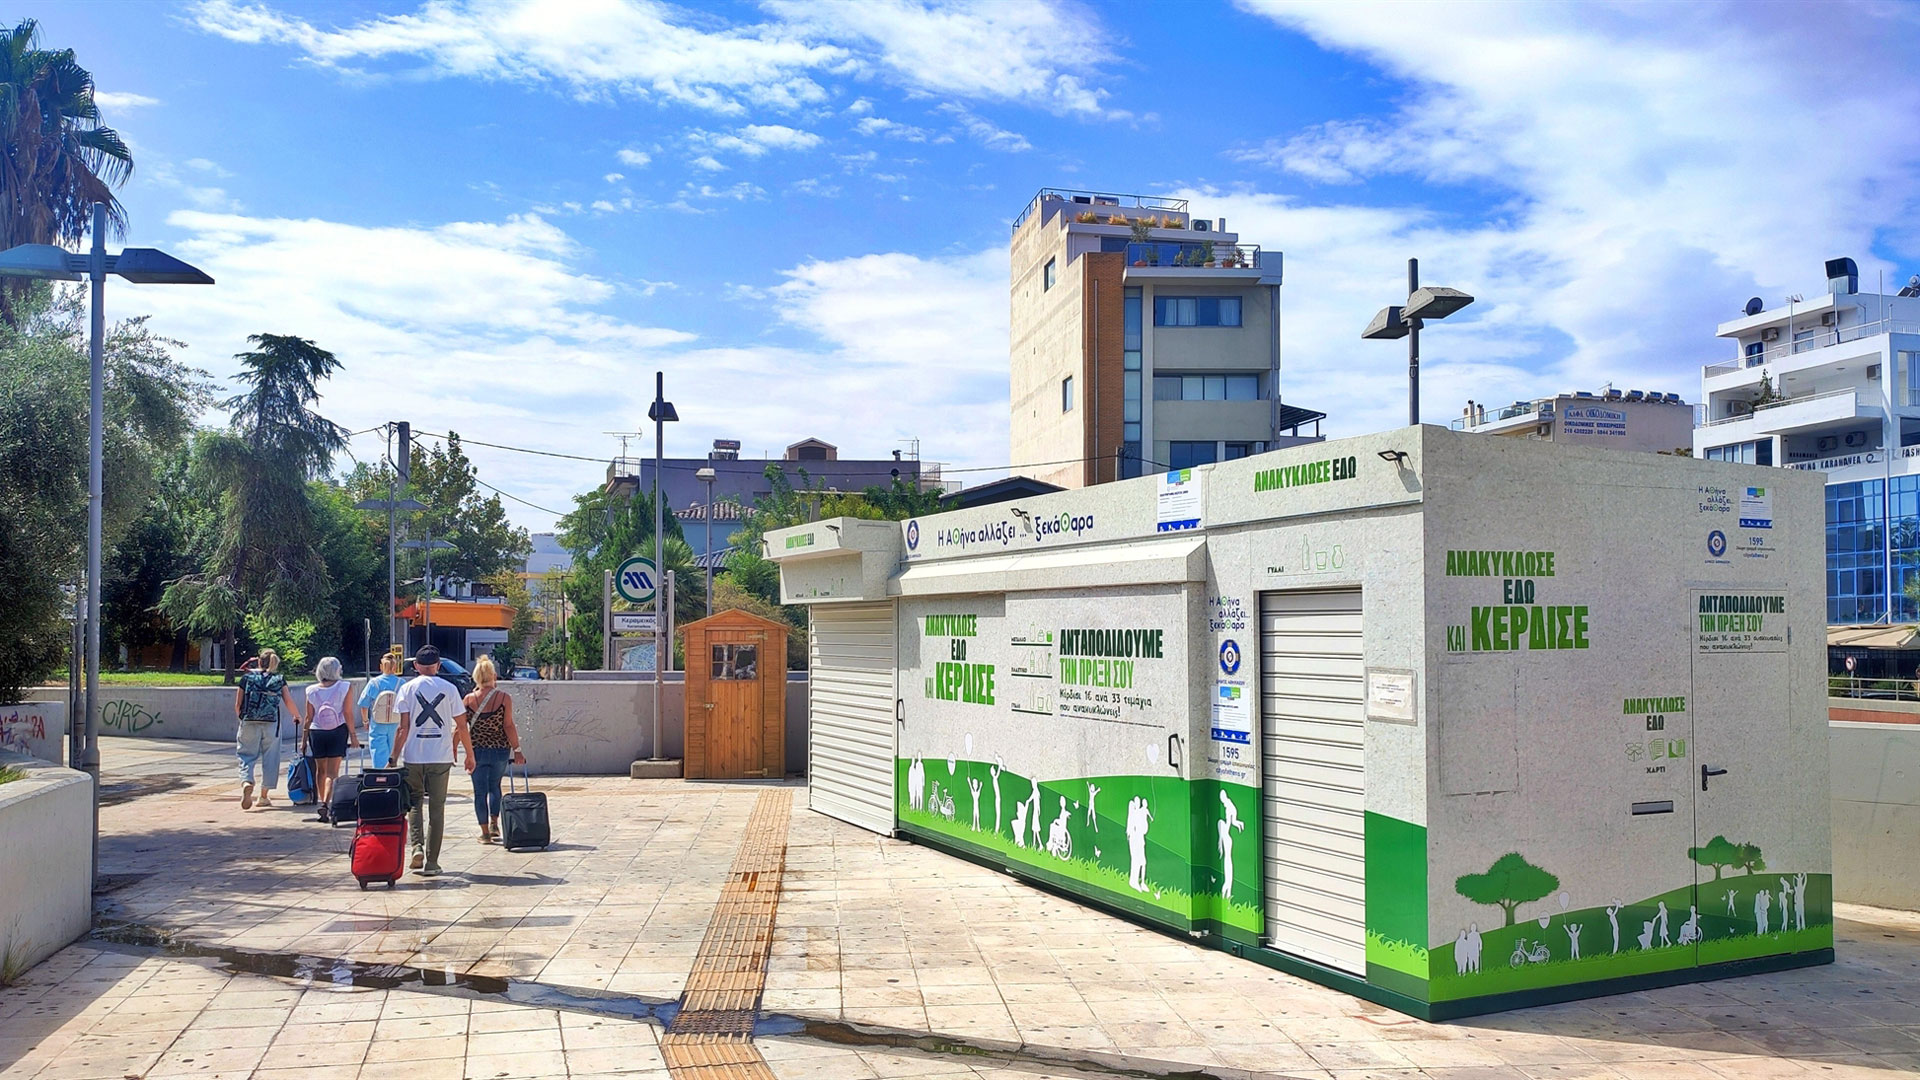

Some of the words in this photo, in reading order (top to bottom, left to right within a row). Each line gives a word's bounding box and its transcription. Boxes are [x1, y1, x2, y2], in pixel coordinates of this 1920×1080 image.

[1254, 460, 1331, 493] ΑΝΑΚΥΚΛΩΣΕ
[1332, 456, 1357, 481] ΕΔΩ
[937, 531, 944, 547] Η
[978, 521, 1016, 545] αλλάζει
[1034, 512, 1094, 542] ξεκάθαρα
[1749, 537, 1763, 545] 1595
[1446, 550, 1555, 576] ΑΝΑΚΥΚΛΩΣΕ
[1209, 596, 1215, 606] Η
[1503, 579, 1535, 604] ΕΔΩ
[1699, 595, 1785, 613] ΑΝΤΑΠΟΔΙΔΟΥΜΕ
[621, 617, 656, 625] Κεραμεικός
[925, 614, 977, 636] ΑΝΑΚΥΚΛΩΣΕ
[1447, 625, 1466, 651] ΚΑΙ
[1471, 605, 1589, 650] ΚΕΡΔΙΣΕ
[1699, 614, 1716, 632] ΤΗΝ
[1717, 614, 1745, 632] ΠΡΑΞΗ
[1746, 614, 1763, 632] ΣΟΥ
[951, 639, 967, 661] ΕΔΩ
[1060, 629, 1163, 658] ΑΝΤΑΠΟΔΙΔΟΥΜΕ
[1059, 658, 1077, 685] ΤΗΝ
[1079, 659, 1111, 687] ΠΡΑΞΗ
[1113, 660, 1134, 688] ΣΟΥ
[925, 677, 934, 698] ΚΑΙ
[936, 661, 995, 706] ΚΕΡΔΙΣΕ
[1095, 691, 1108, 702] ανά
[1112, 693, 1120, 703] 33
[1123, 693, 1152, 710] τεμάχια
[1623, 696, 1685, 714] ΑΝΑΚΥΚΛΩΣΕ
[1646, 715, 1664, 731] ΕΔΩ
[1222, 746, 1240, 759] 1595
[1646, 766, 1665, 774] ΧΑΡΤΙ
